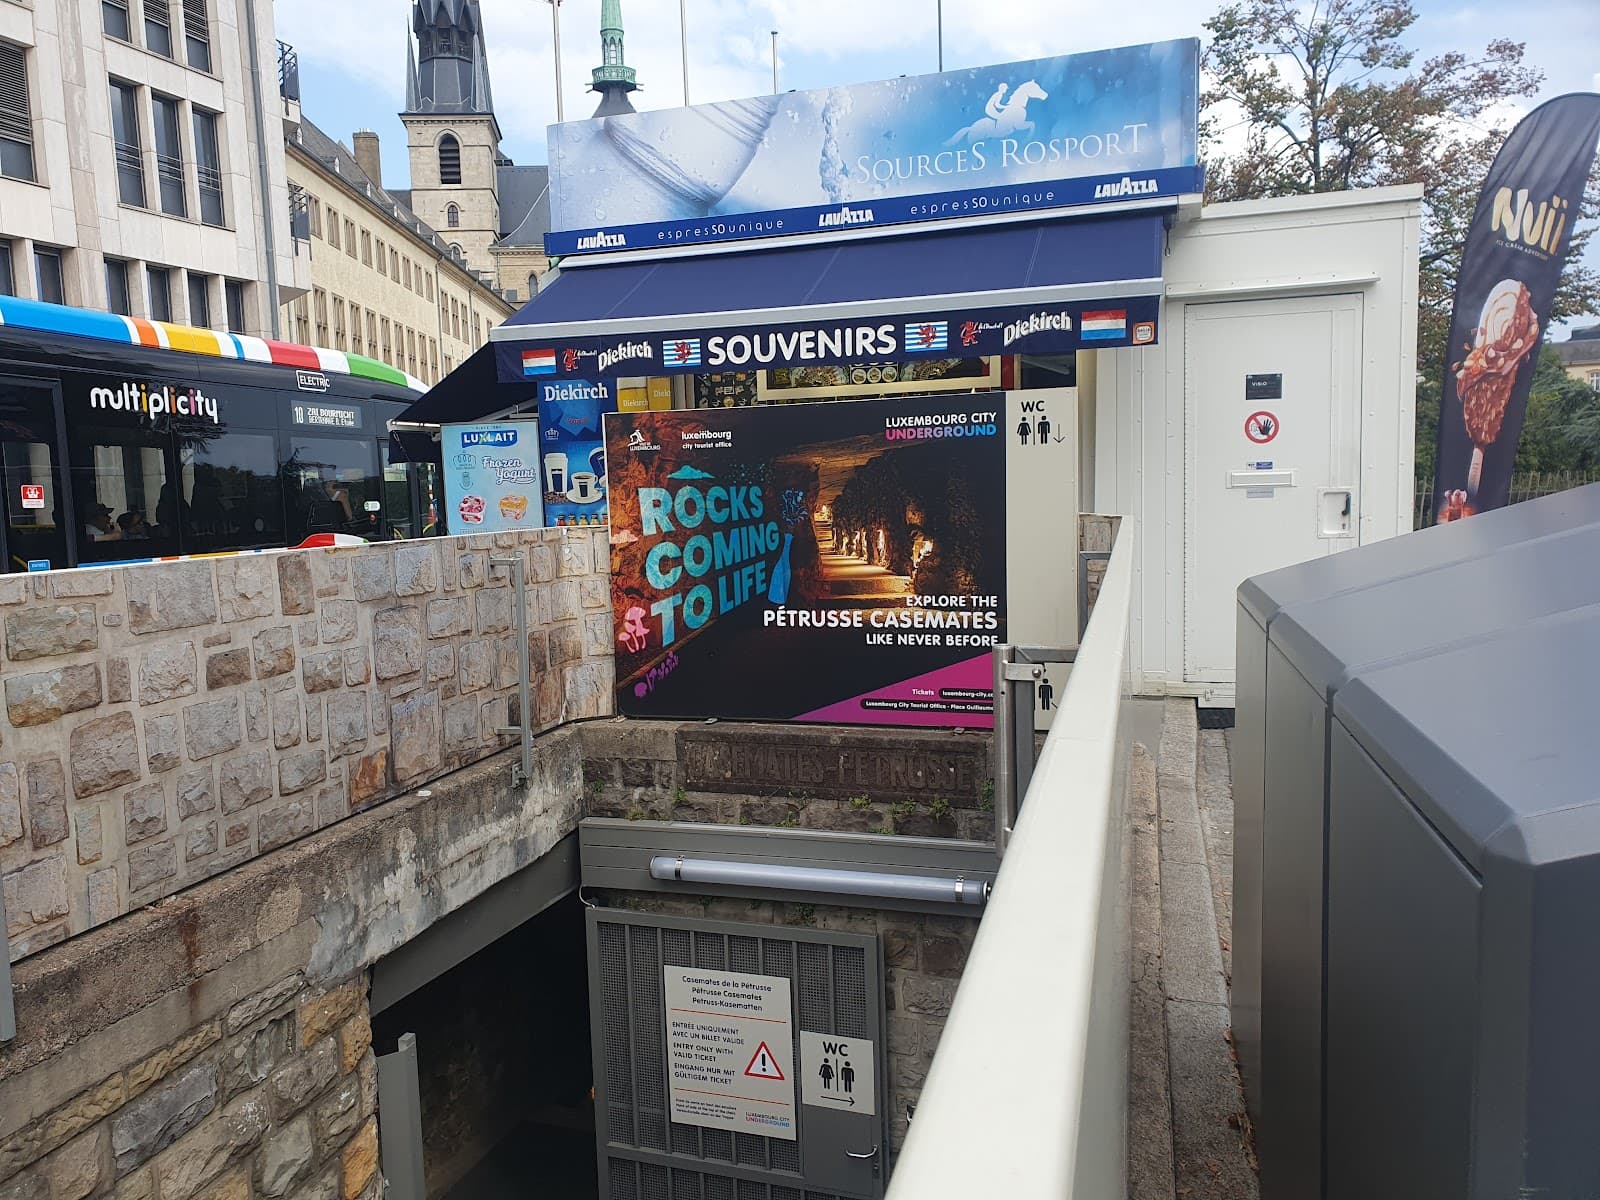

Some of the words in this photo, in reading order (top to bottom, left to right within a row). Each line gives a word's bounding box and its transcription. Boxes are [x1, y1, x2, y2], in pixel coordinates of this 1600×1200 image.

[857, 141, 986, 184] SOURCES
[1002, 122, 1148, 168] ROSPORT
[1094, 177, 1159, 199] LAVAZZA
[818, 206, 874, 227] LAVAZZA
[577, 231, 626, 250] LAVAZZA
[1003, 311, 1073, 347] Diekirch
[707, 324, 897, 366] SOUVENIRS
[598, 341, 653, 373] Diekirch
[300, 375, 331, 388] ELECTRIC
[543, 382, 609, 402] Diekirch
[90, 382, 219, 424] multiplicity
[1021, 400, 1046, 413] WC
[294, 406, 304, 424] 10
[885, 413, 967, 428] LUXEMBOURG
[971, 412, 997, 424] CITY
[463, 431, 515, 444] LUXLAIT
[885, 424, 997, 441] UNDERGROUND
[481, 455, 522, 469] Frozen
[495, 466, 536, 485] Yogurt
[637, 485, 764, 536] ROCKS
[645, 521, 780, 590] COMING
[651, 584, 713, 647] TO
[718, 560, 767, 616] LIFE
[906, 595, 967, 608] EXPLORE
[971, 595, 998, 608] THE
[763, 605, 863, 628] PÉTRUSSE
[870, 610, 998, 630] CASEMATES
[866, 633, 893, 645] LIKE
[897, 633, 941, 646] NEVER
[946, 634, 998, 647] BEFORE
[682, 975, 720, 987] Casemates
[741, 981, 772, 992] Pétrusse
[692, 986, 722, 996] Pétrusse
[723, 990, 762, 1001] Casemates
[692, 997, 763, 1011] Petruss-Kasematten
[672, 1021, 695, 1030] ENTRÉE
[696, 1024, 739, 1035] UNIQUEMENT
[672, 1030, 688, 1038] AVEC
[701, 1034, 721, 1042] BILLET
[722, 1036, 745, 1045] VALIDE
[673, 1042, 694, 1050] ENTRY
[695, 1044, 714, 1053] ONLY
[715, 1047, 734, 1055] WITH
[673, 1050, 693, 1059] VALID
[694, 1053, 717, 1062] TICKET
[822, 1041, 849, 1057] WC
[674, 1062, 705, 1073] EINGANG
[706, 1066, 721, 1074] NUR
[674, 1070, 708, 1082] GÜLTIGEM
[710, 1076, 732, 1085] TICKET
[745, 1116, 790, 1127] UNDERGROUND
